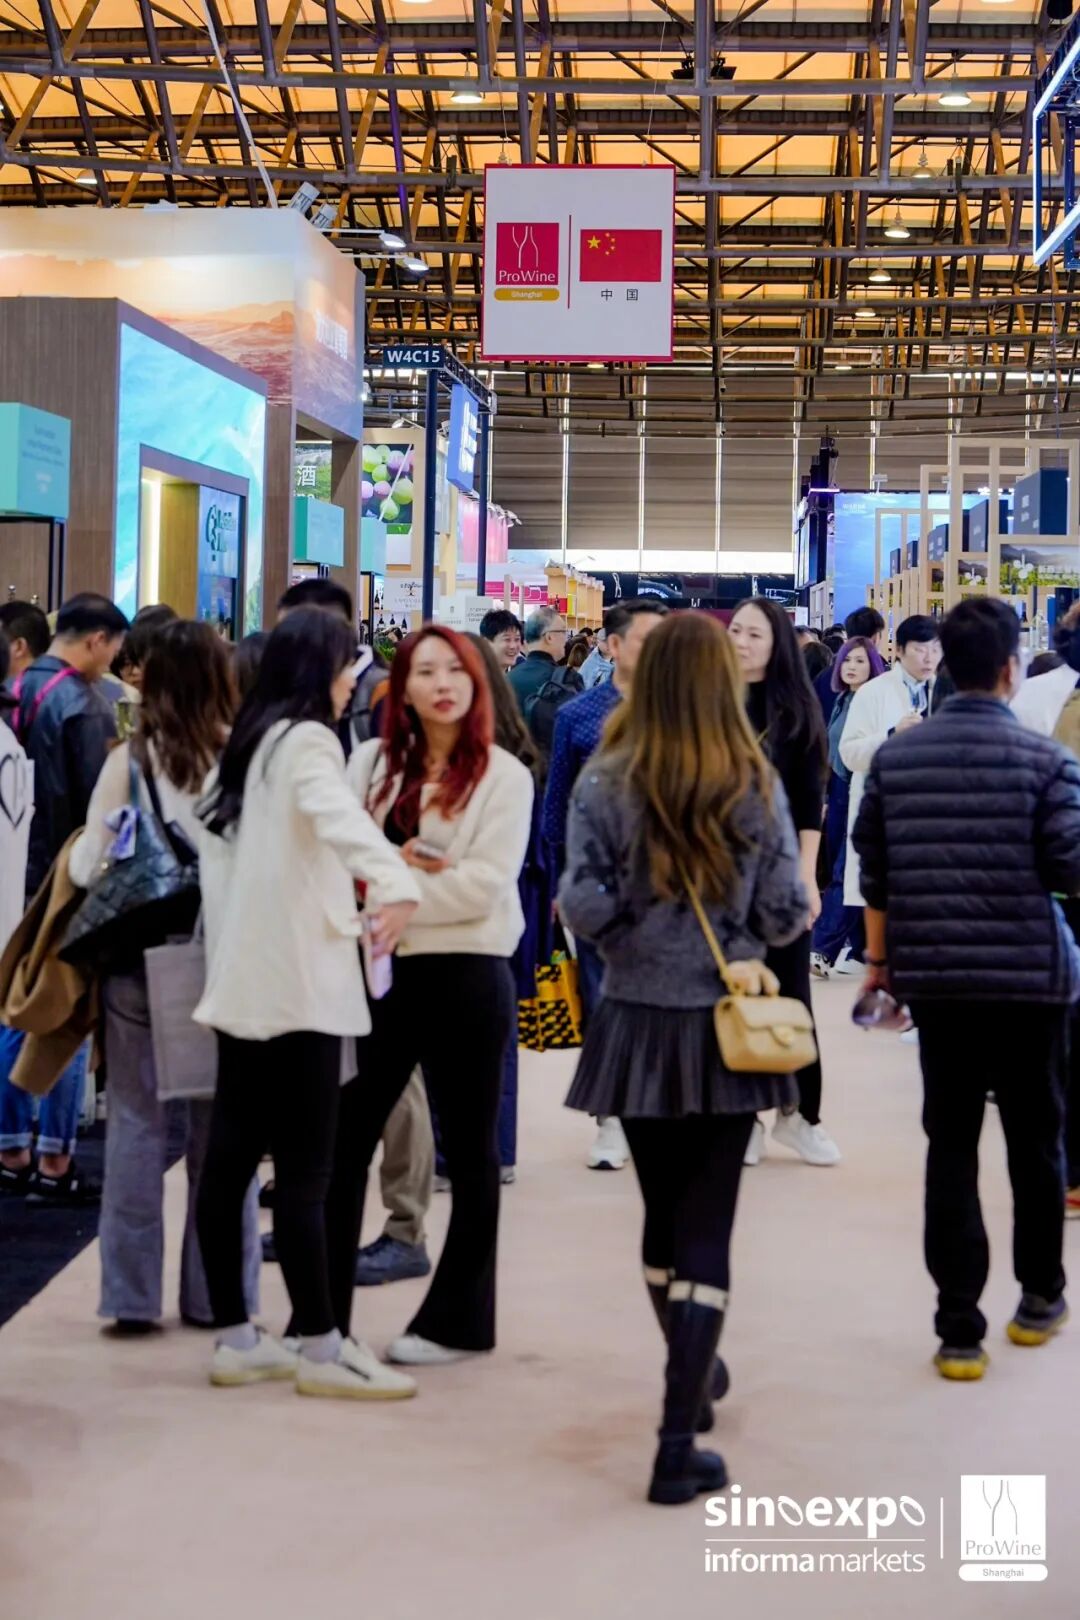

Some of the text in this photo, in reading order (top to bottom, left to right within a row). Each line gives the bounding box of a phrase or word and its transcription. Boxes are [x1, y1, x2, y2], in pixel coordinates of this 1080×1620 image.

[499, 270, 556, 282] ProWine
[601, 288, 639, 302] 中国
[387, 350, 440, 363] W4C15
